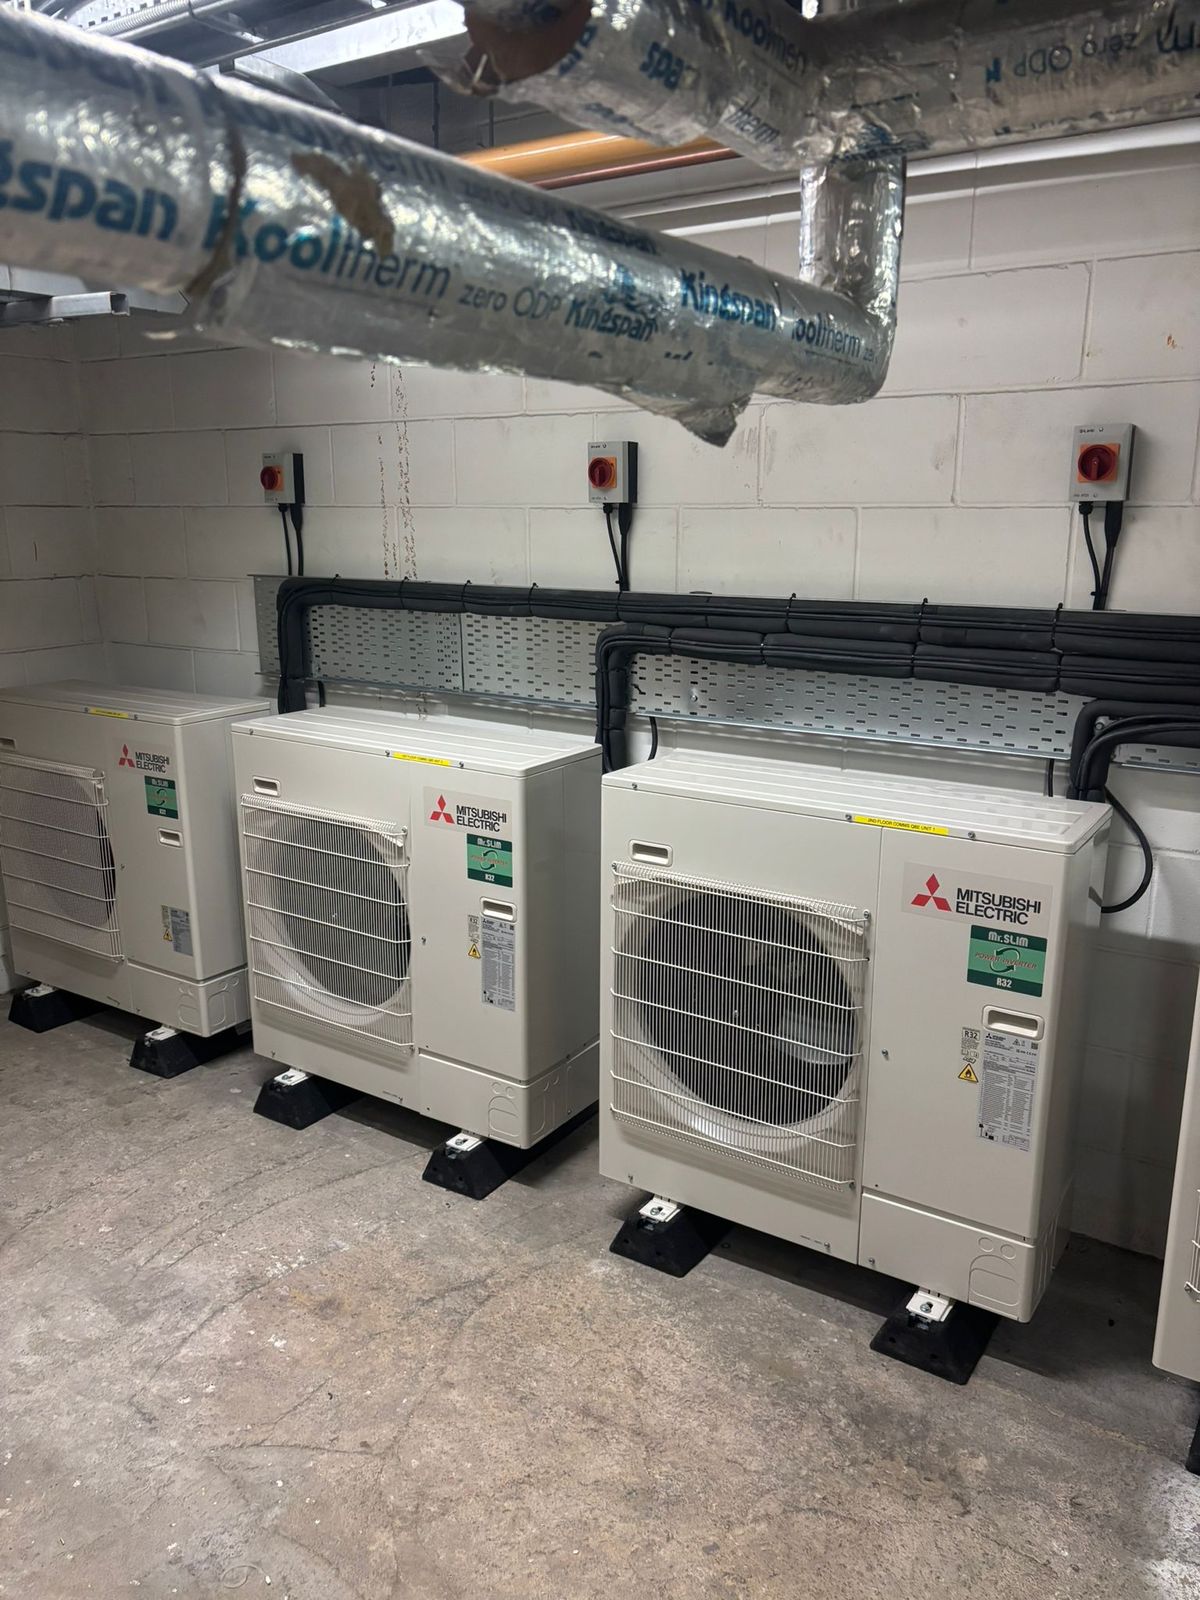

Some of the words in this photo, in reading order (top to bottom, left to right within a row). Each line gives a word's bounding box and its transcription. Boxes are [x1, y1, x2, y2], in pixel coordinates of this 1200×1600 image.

[1013, 45, 1072, 78] ODP
[203, 194, 452, 299] Kooltherm
[458, 283, 507, 312] zero
[512, 286, 562, 321] ODP
[791, 309, 861, 358] ooltherm
[135, 751, 170, 765] MITSUBISHI
[136, 760, 167, 773] ELECTRIC
[456, 804, 507, 823] MITSUBISHI
[456, 815, 500, 832] ELECTRIC
[956, 887, 1042, 914] MITSUBISHI
[955, 901, 1029, 925] ELECTRIC
[988, 931, 1029, 947] Mr.SLIM
[996, 977, 1012, 988] R32
[964, 1030, 978, 1039] R32
